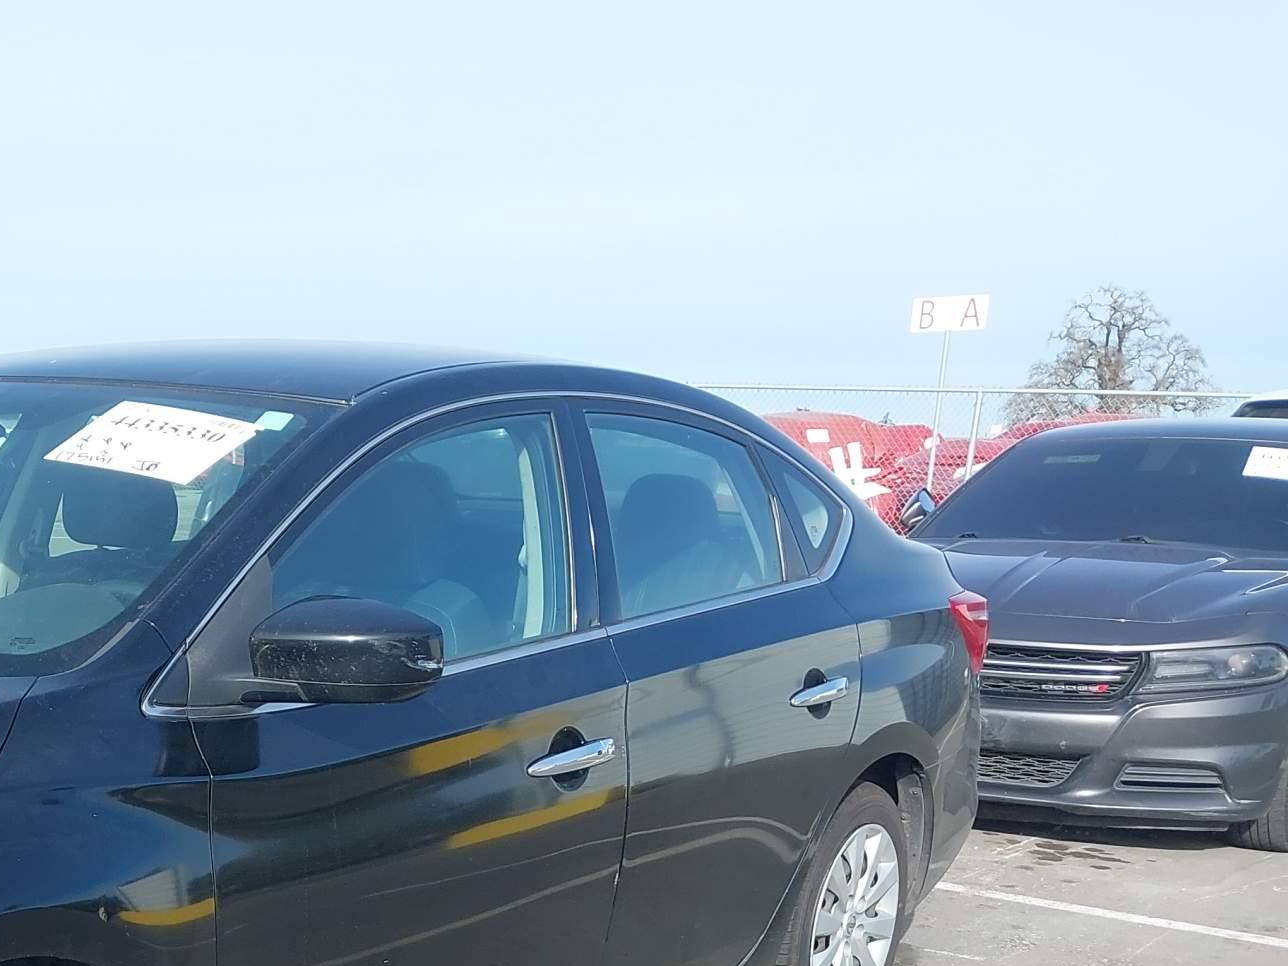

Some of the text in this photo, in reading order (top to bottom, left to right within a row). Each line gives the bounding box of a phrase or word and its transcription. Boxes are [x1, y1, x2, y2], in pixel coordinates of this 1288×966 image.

[919, 297, 980, 329] B A
[112, 415, 225, 442] 44335330
